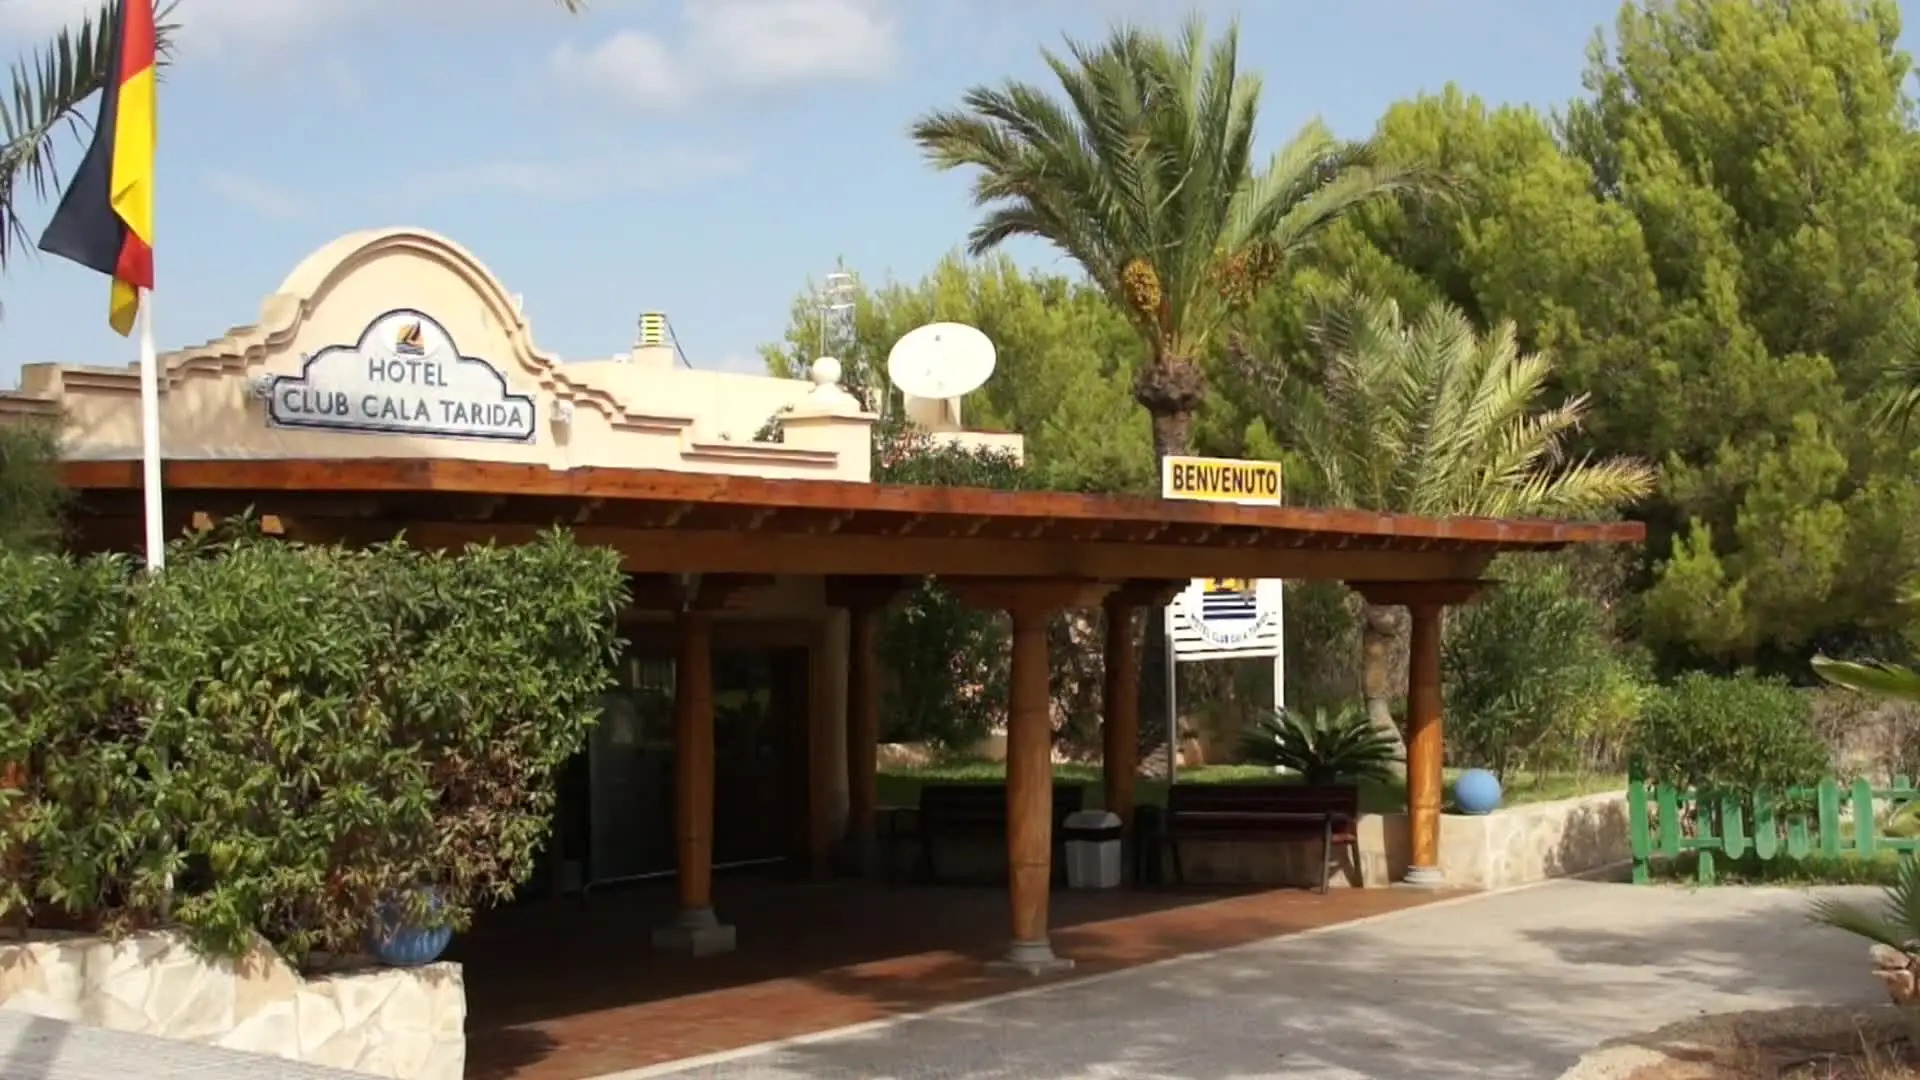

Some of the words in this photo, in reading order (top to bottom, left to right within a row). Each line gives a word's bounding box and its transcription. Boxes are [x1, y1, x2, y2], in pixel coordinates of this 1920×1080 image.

[368, 358, 448, 387] HOTEL
[283, 390, 349, 416] CLUB
[361, 395, 431, 422] CALA
[440, 400, 524, 428] TARIDA
[1172, 463, 1278, 495] BENVENUTO
